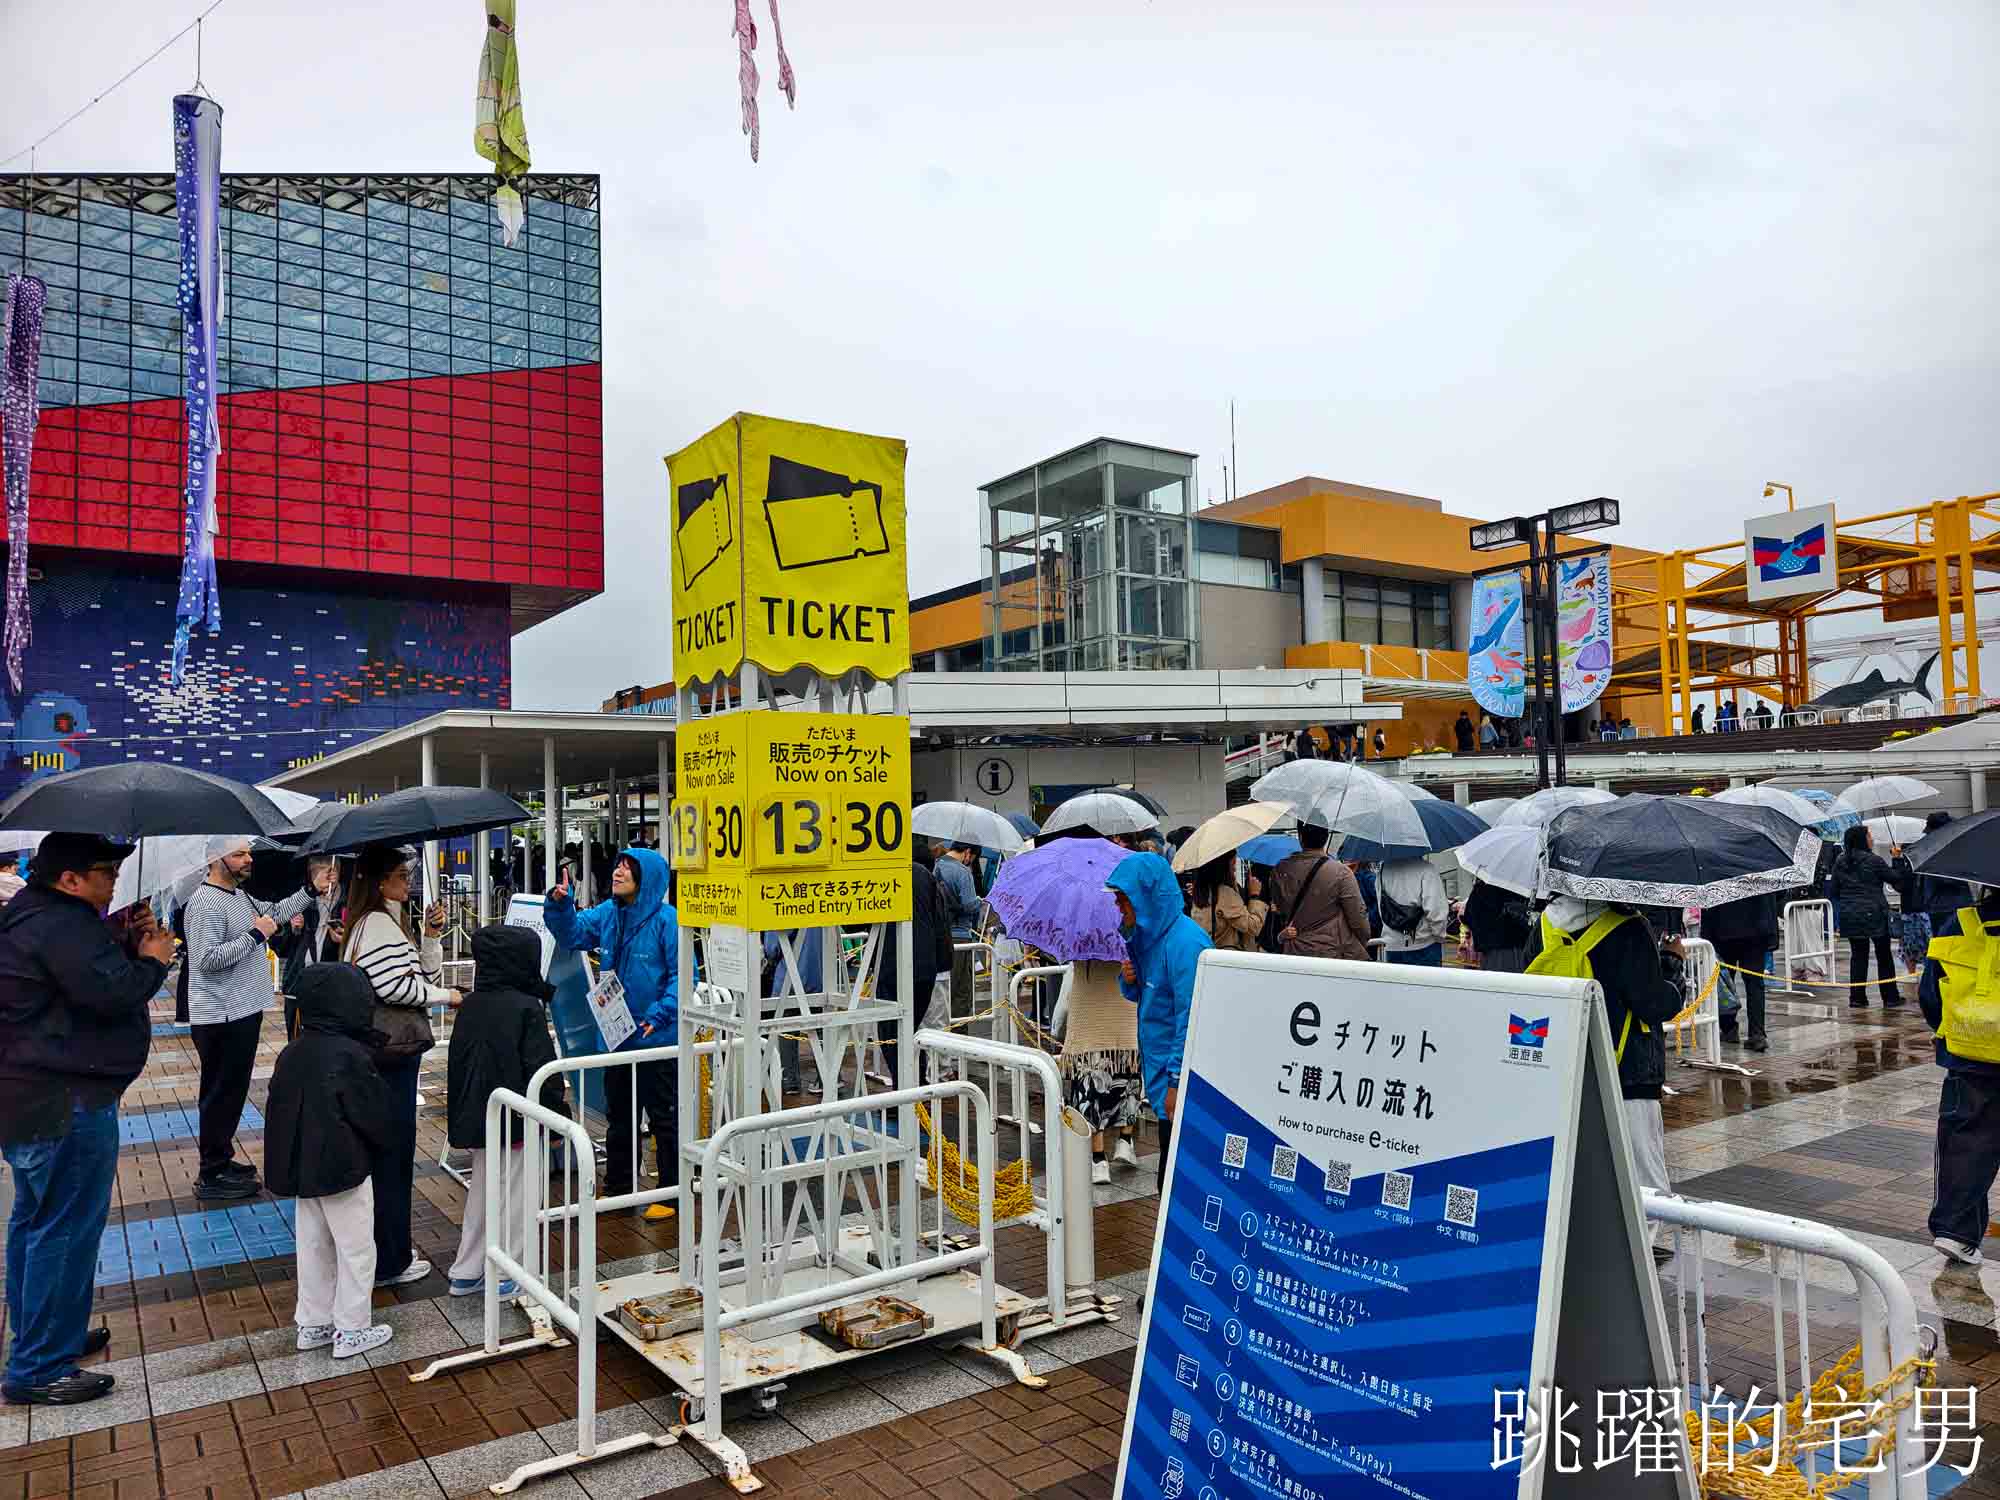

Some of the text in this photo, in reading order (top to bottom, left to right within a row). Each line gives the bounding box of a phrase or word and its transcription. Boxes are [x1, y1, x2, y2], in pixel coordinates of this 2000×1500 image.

[1597, 566, 1609, 637] KAIYUKAN
[677, 601, 736, 654] TICKET
[760, 597, 895, 643] TICKET
[1567, 686, 1601, 709] Welcome
[698, 731, 720, 746] ただいま
[807, 727, 857, 741] ただいま
[683, 745, 736, 771] 販売のチケット
[769, 743, 892, 765] 販売のチケット
[686, 768, 735, 789] Now on Sale
[776, 766, 888, 783] Now on Sale
[673, 804, 743, 858] 13:30
[762, 800, 903, 855] 13:30
[681, 883, 742, 899] に入館できるチケット
[761, 879, 901, 901] に入館できるチケット
[686, 900, 737, 918] Timed Entry Ticket
[774, 896, 892, 917] Timed Entry Ticket
[1278, 1061, 1434, 1120] ご購入の流れ
[1279, 1115, 1420, 1155] How to purchase e-ticket
[1269, 1181, 1294, 1193] English
[1265, 1213, 1335, 1244] スマートフォンで
